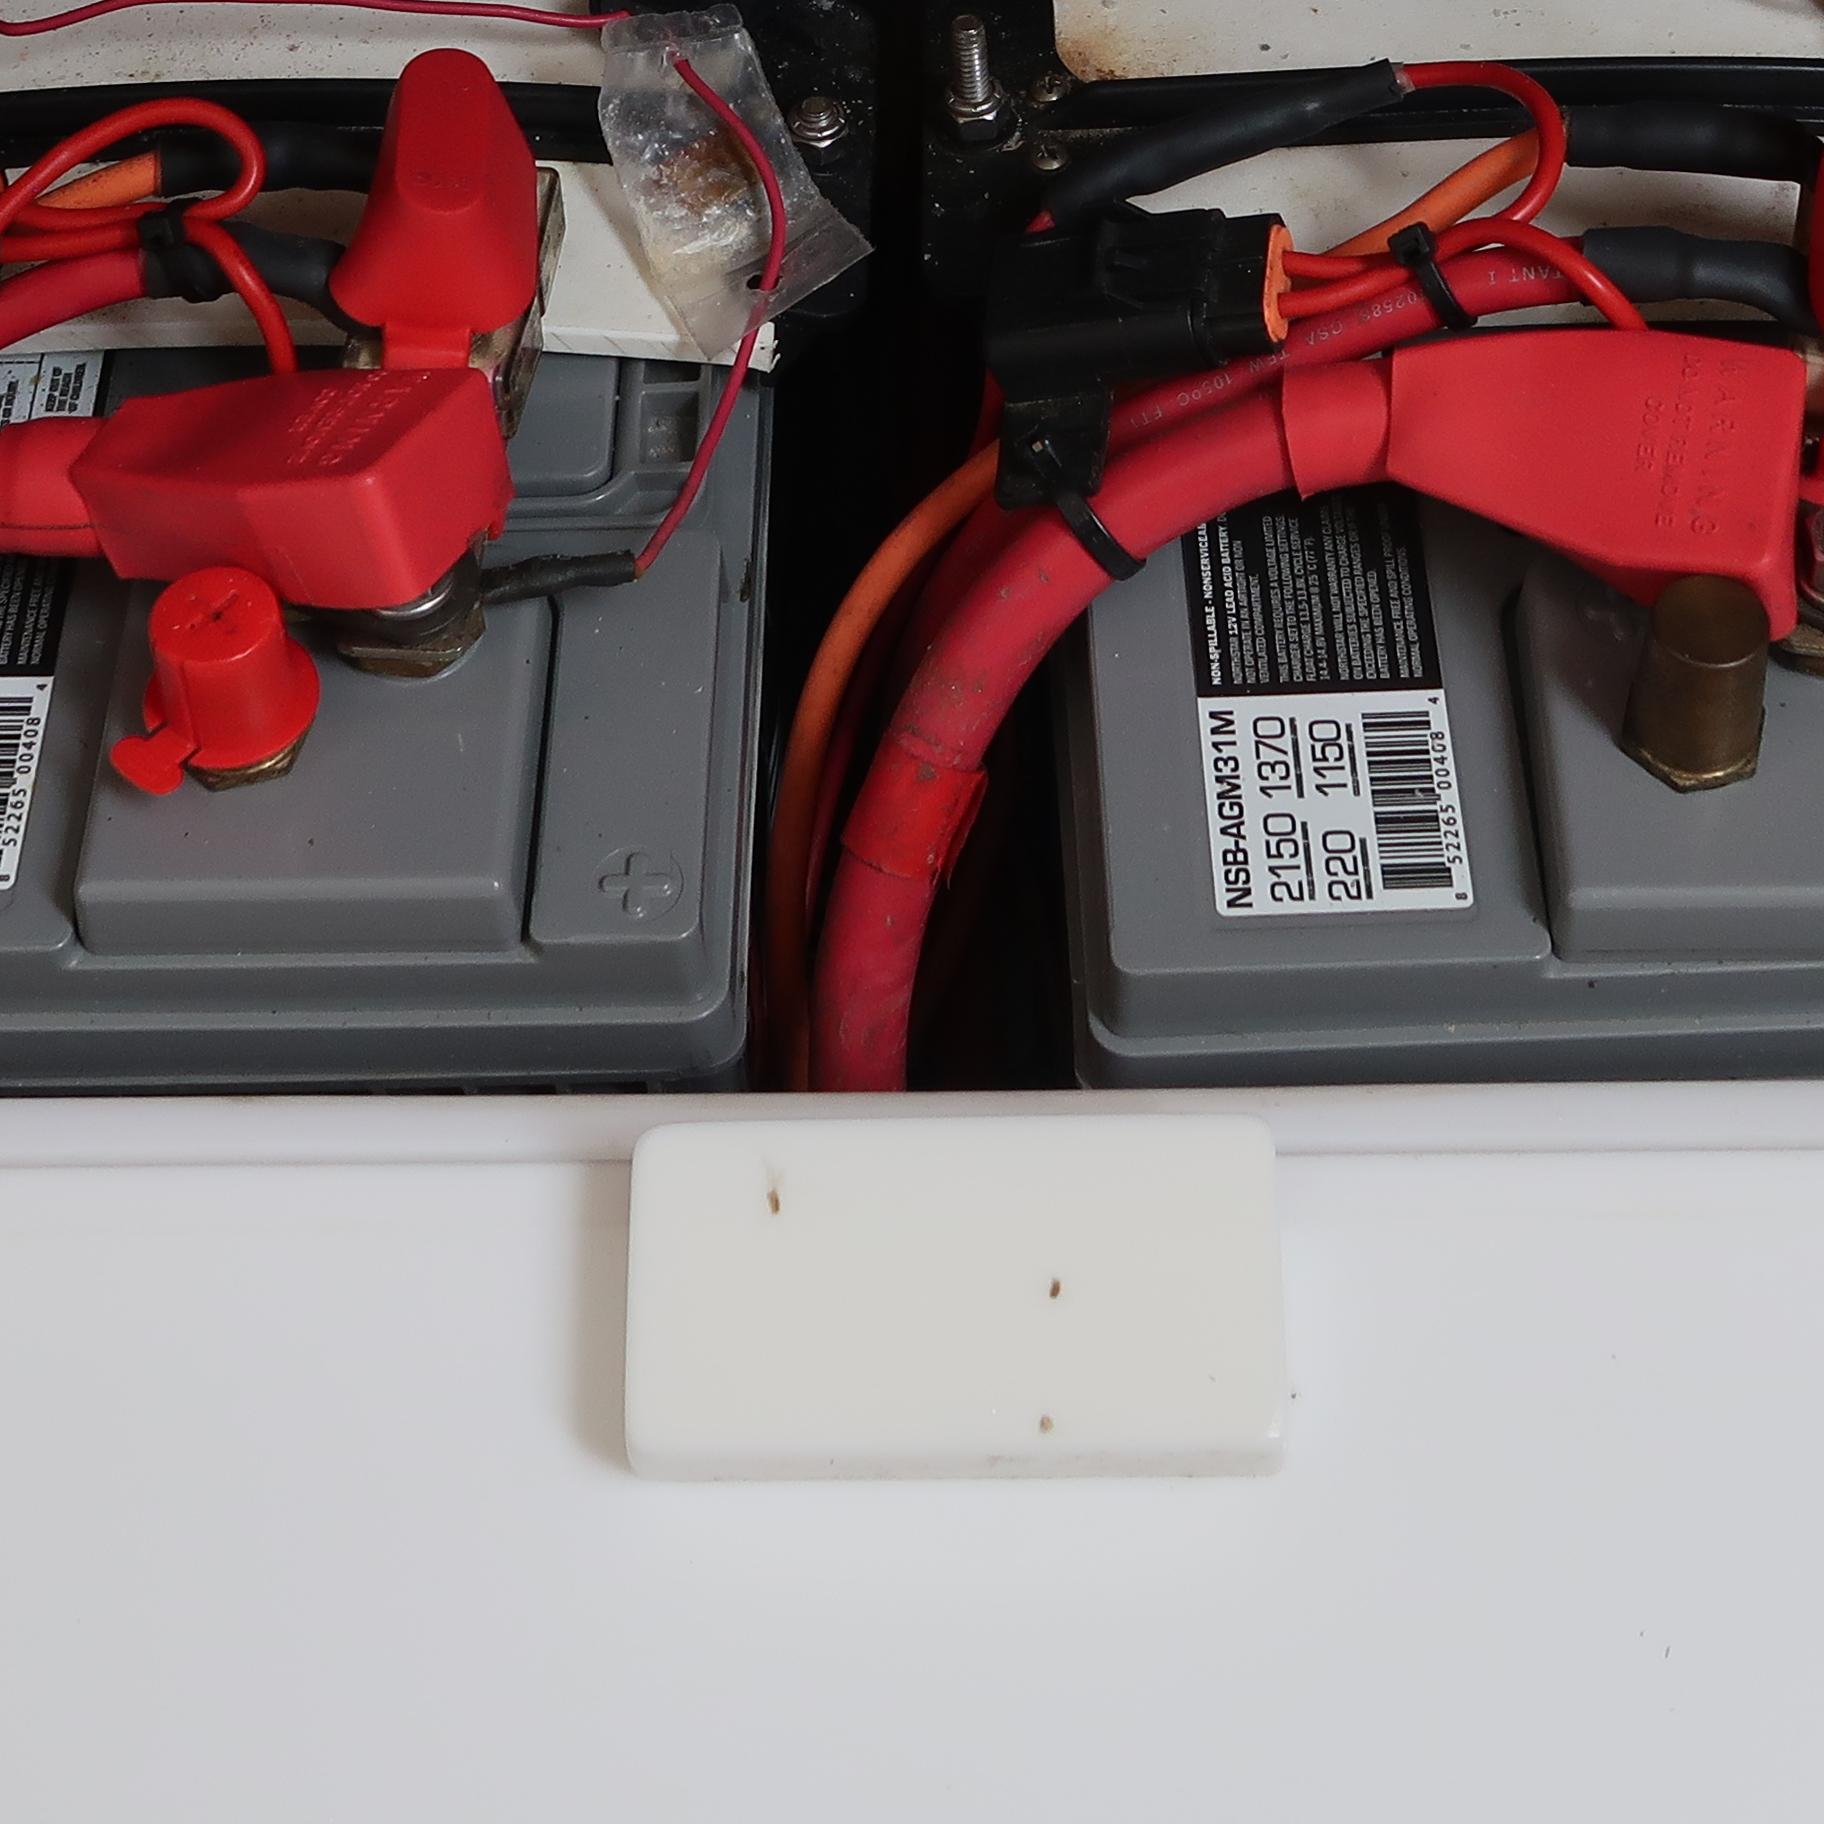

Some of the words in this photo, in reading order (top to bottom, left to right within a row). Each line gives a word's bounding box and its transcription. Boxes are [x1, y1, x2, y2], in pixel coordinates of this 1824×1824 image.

[1304, 318, 1345, 346] CSA
[1195, 521, 1214, 598] NONSERVICEAB
[1221, 565, 1234, 587] ACID
[1224, 589, 1236, 614] LEAD
[1226, 615, 1239, 635] 12V
[1203, 606, 1223, 685] NON-SPILLABLE
[1427, 695, 1440, 706] 4
[1, 787, 27, 848] 52265
[17, 716, 42, 775] 00408
[36, 683, 48, 692] 4
[1253, 716, 1291, 799] 1370
[1308, 719, 1347, 797] 1150
[1428, 729, 1453, 790] 00408
[1209, 709, 1253, 910] NSB-AGM31M
[1443, 804, 1464, 864] 52265
[1263, 811, 1304, 903] 2150
[1321, 829, 1362, 902] 220
[1455, 891, 1467, 900] 8
